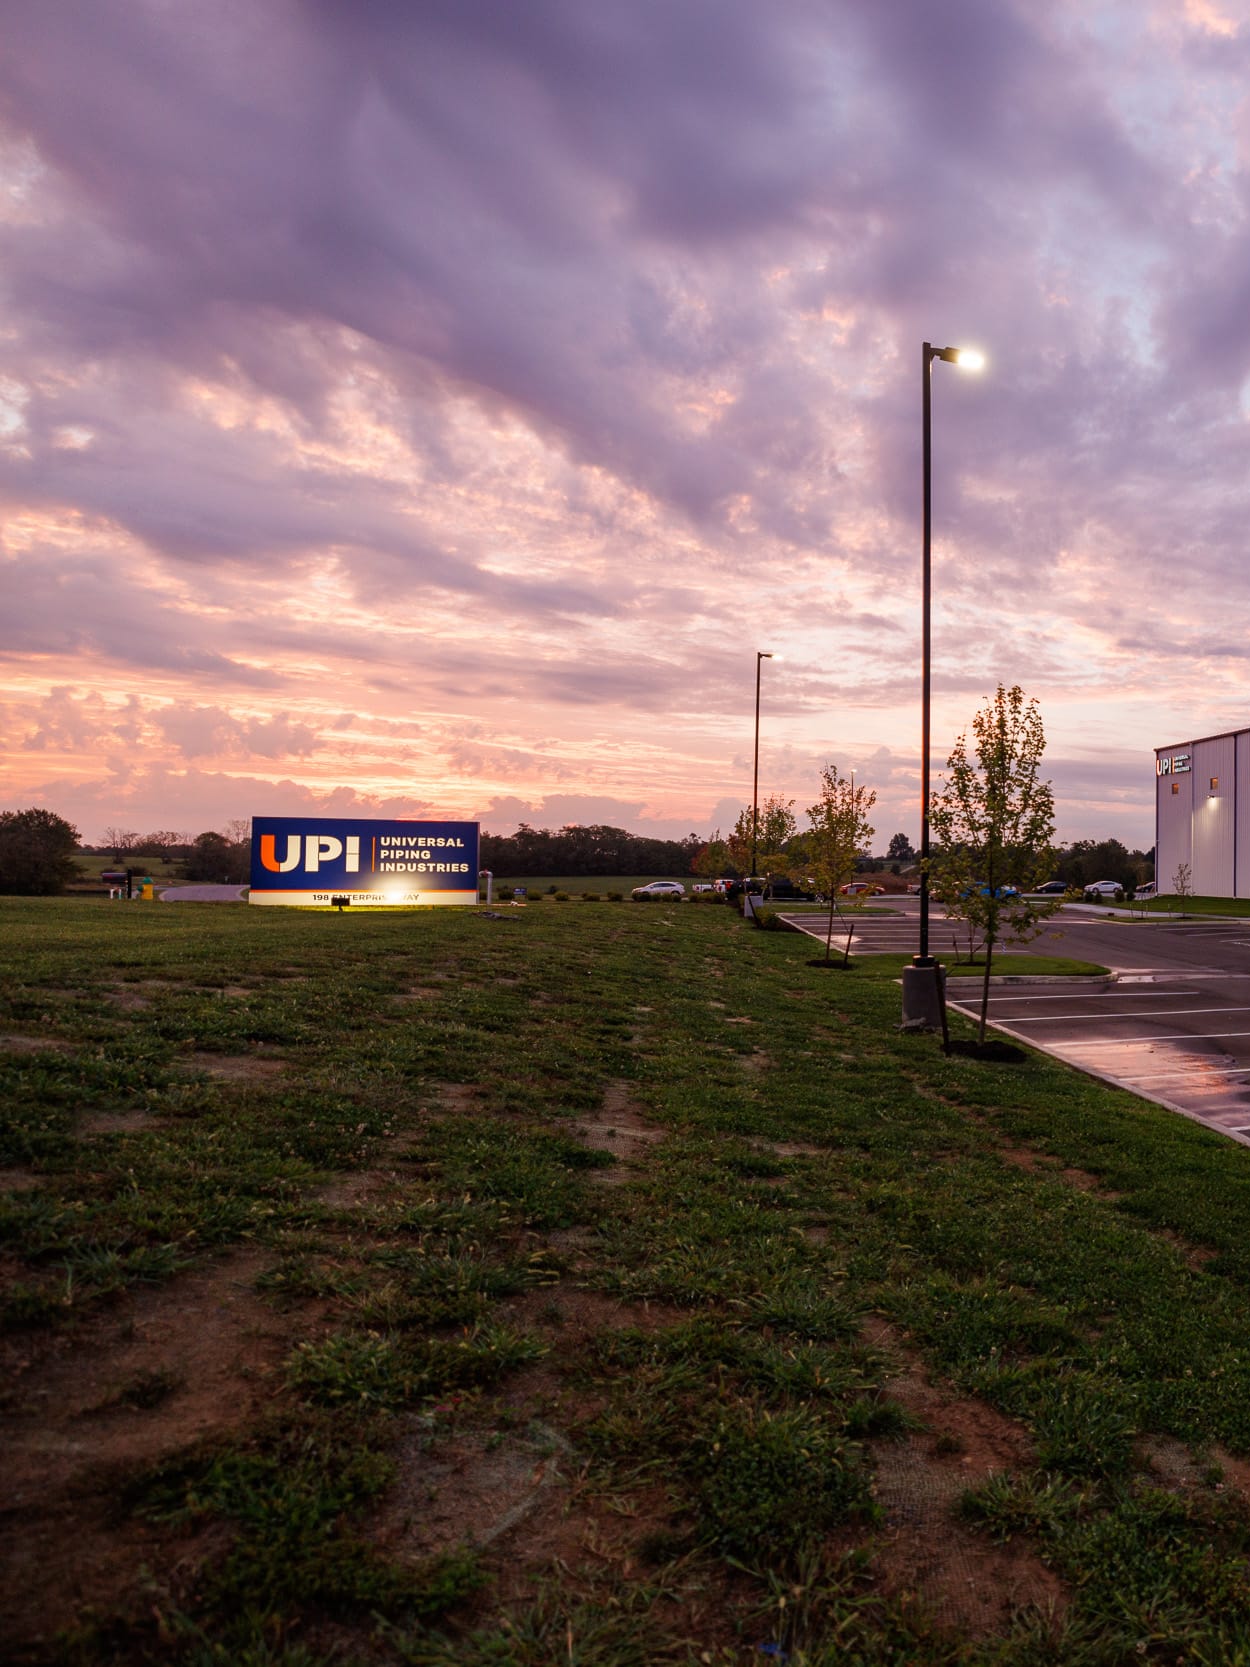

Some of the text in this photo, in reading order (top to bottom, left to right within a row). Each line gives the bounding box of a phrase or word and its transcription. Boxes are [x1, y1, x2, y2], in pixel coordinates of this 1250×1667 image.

[1156, 758, 1172, 776] UPI
[379, 836, 465, 848] UNIVERSAL
[260, 834, 360, 873] UPI
[379, 849, 431, 860] PIPING
[379, 862, 470, 873] INDUSTRIES
